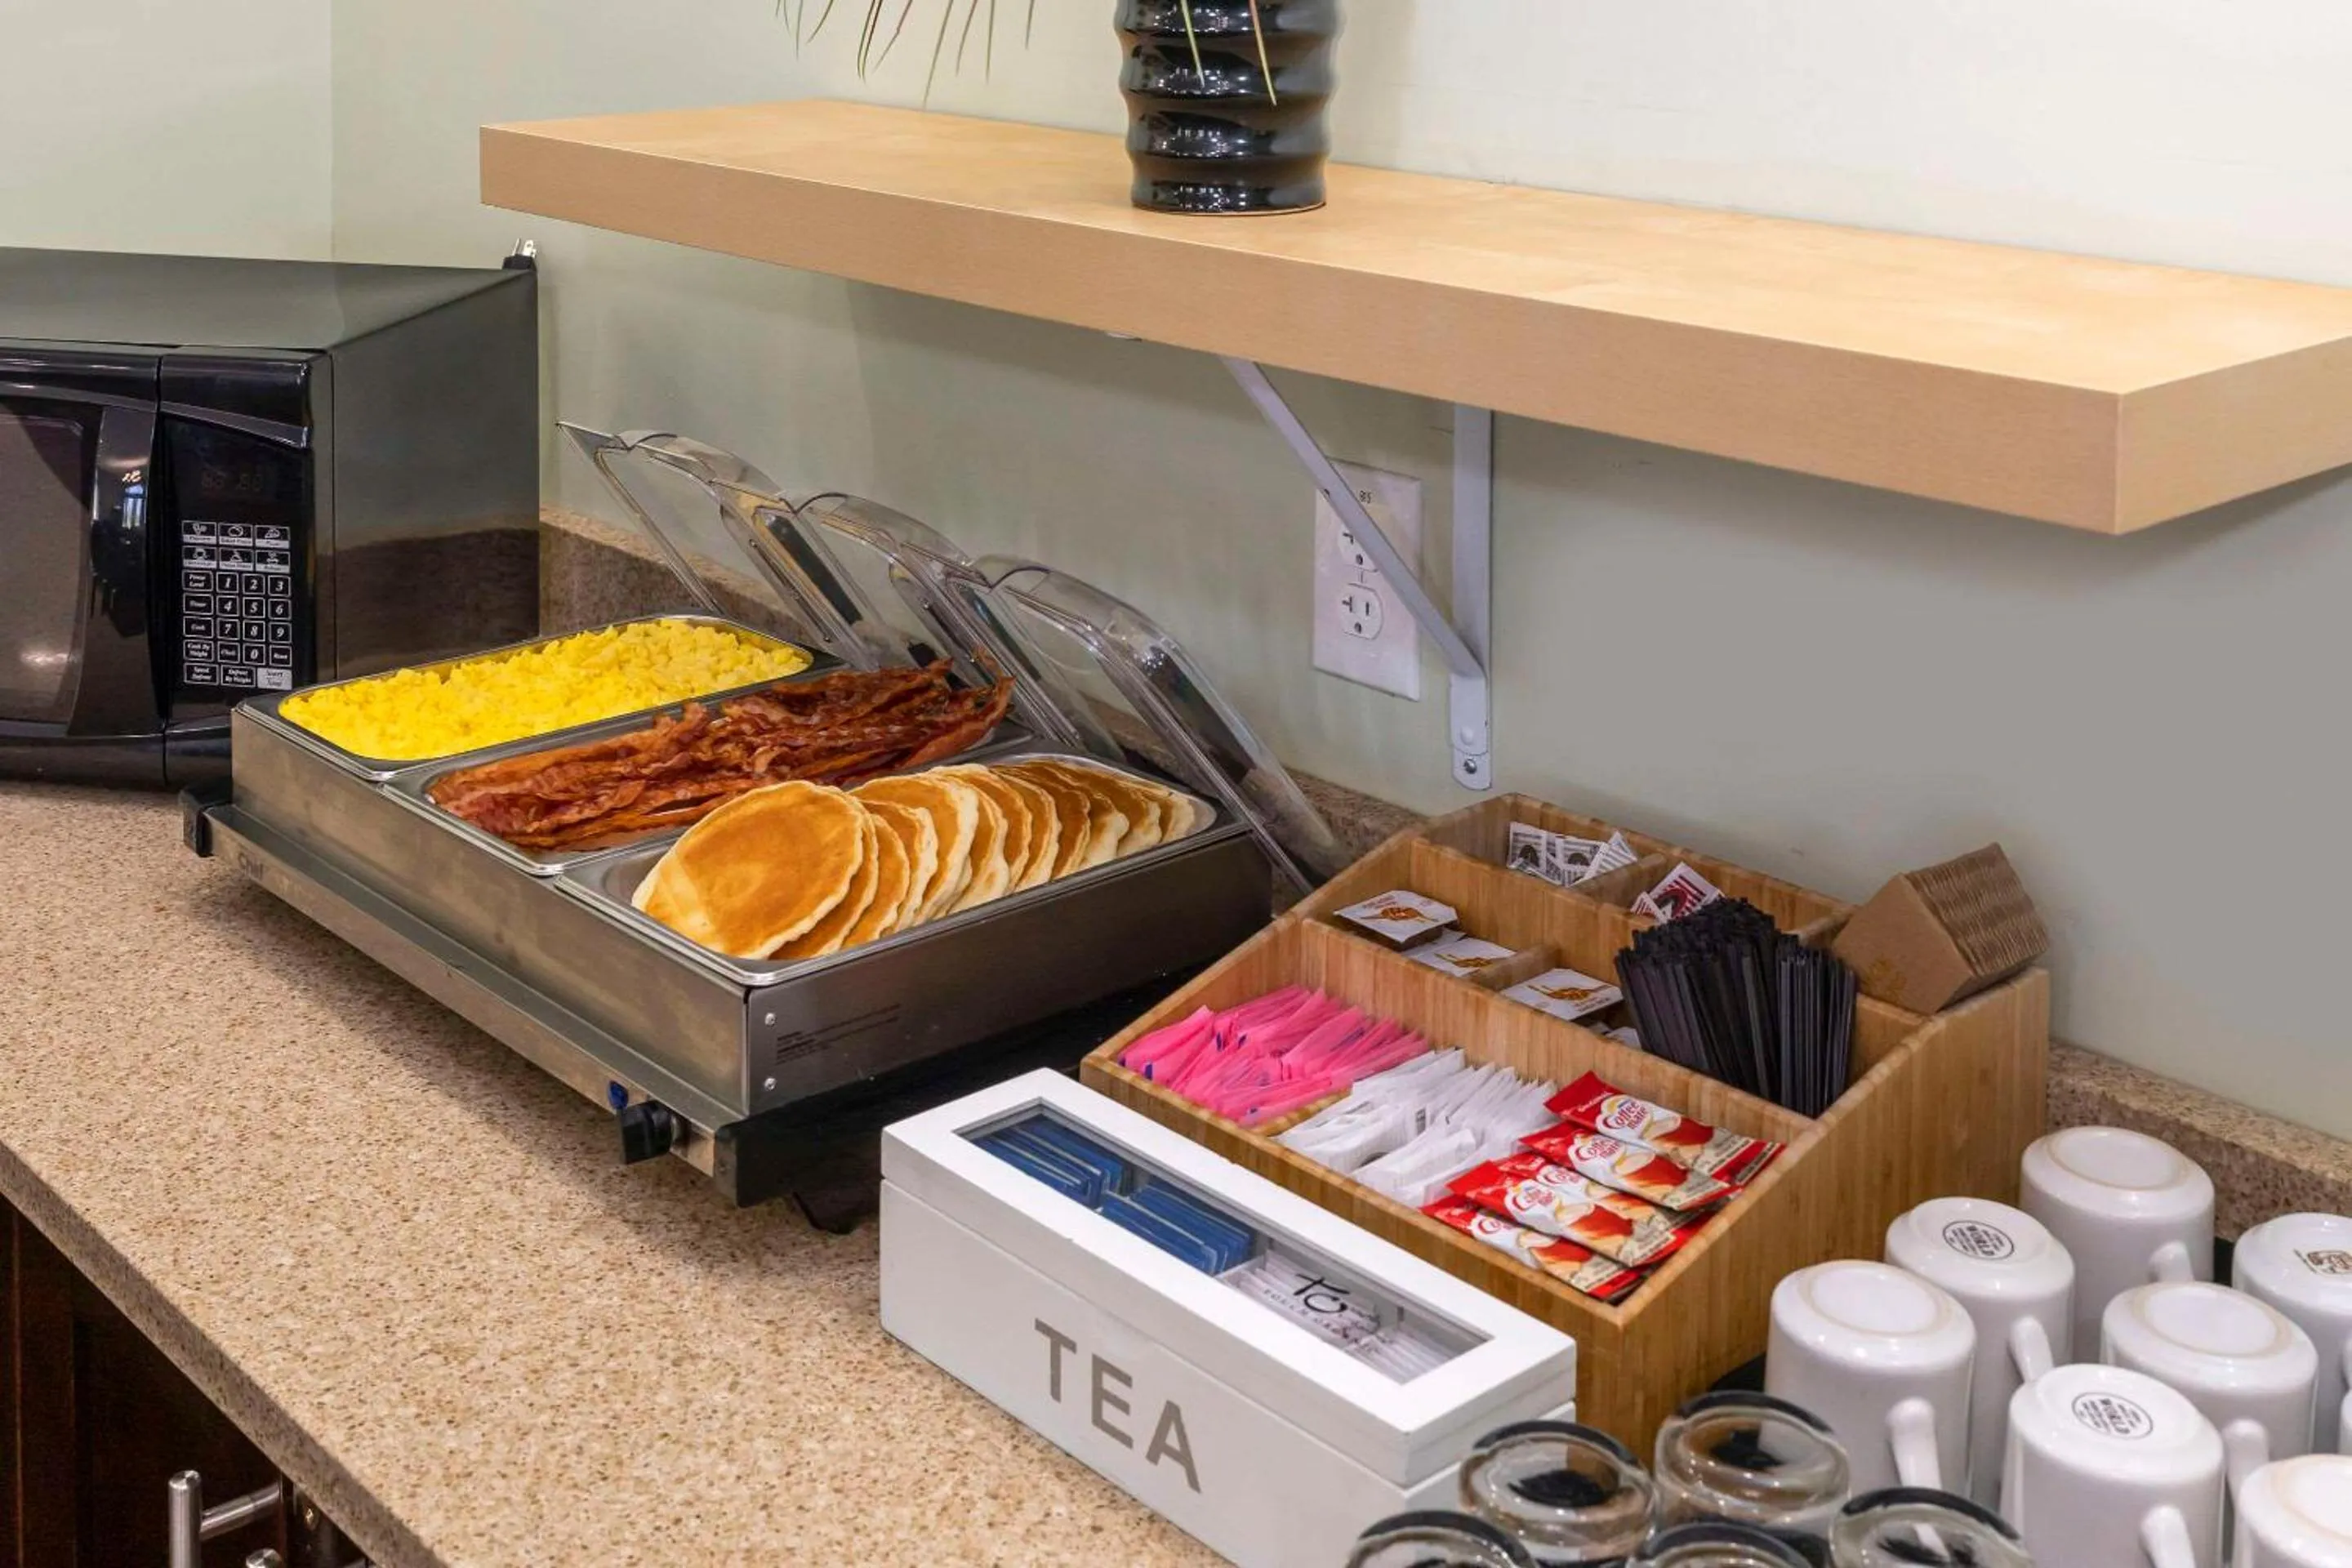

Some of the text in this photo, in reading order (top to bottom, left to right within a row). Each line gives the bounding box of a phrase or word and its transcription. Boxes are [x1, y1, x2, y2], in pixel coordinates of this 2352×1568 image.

[225, 577, 283, 591] 1 2 3
[224, 600, 283, 615] 4 5 6
[225, 623, 284, 638] 7 8 9
[250, 648, 258, 659] 0
[1035, 1317, 1201, 1494] TEA
